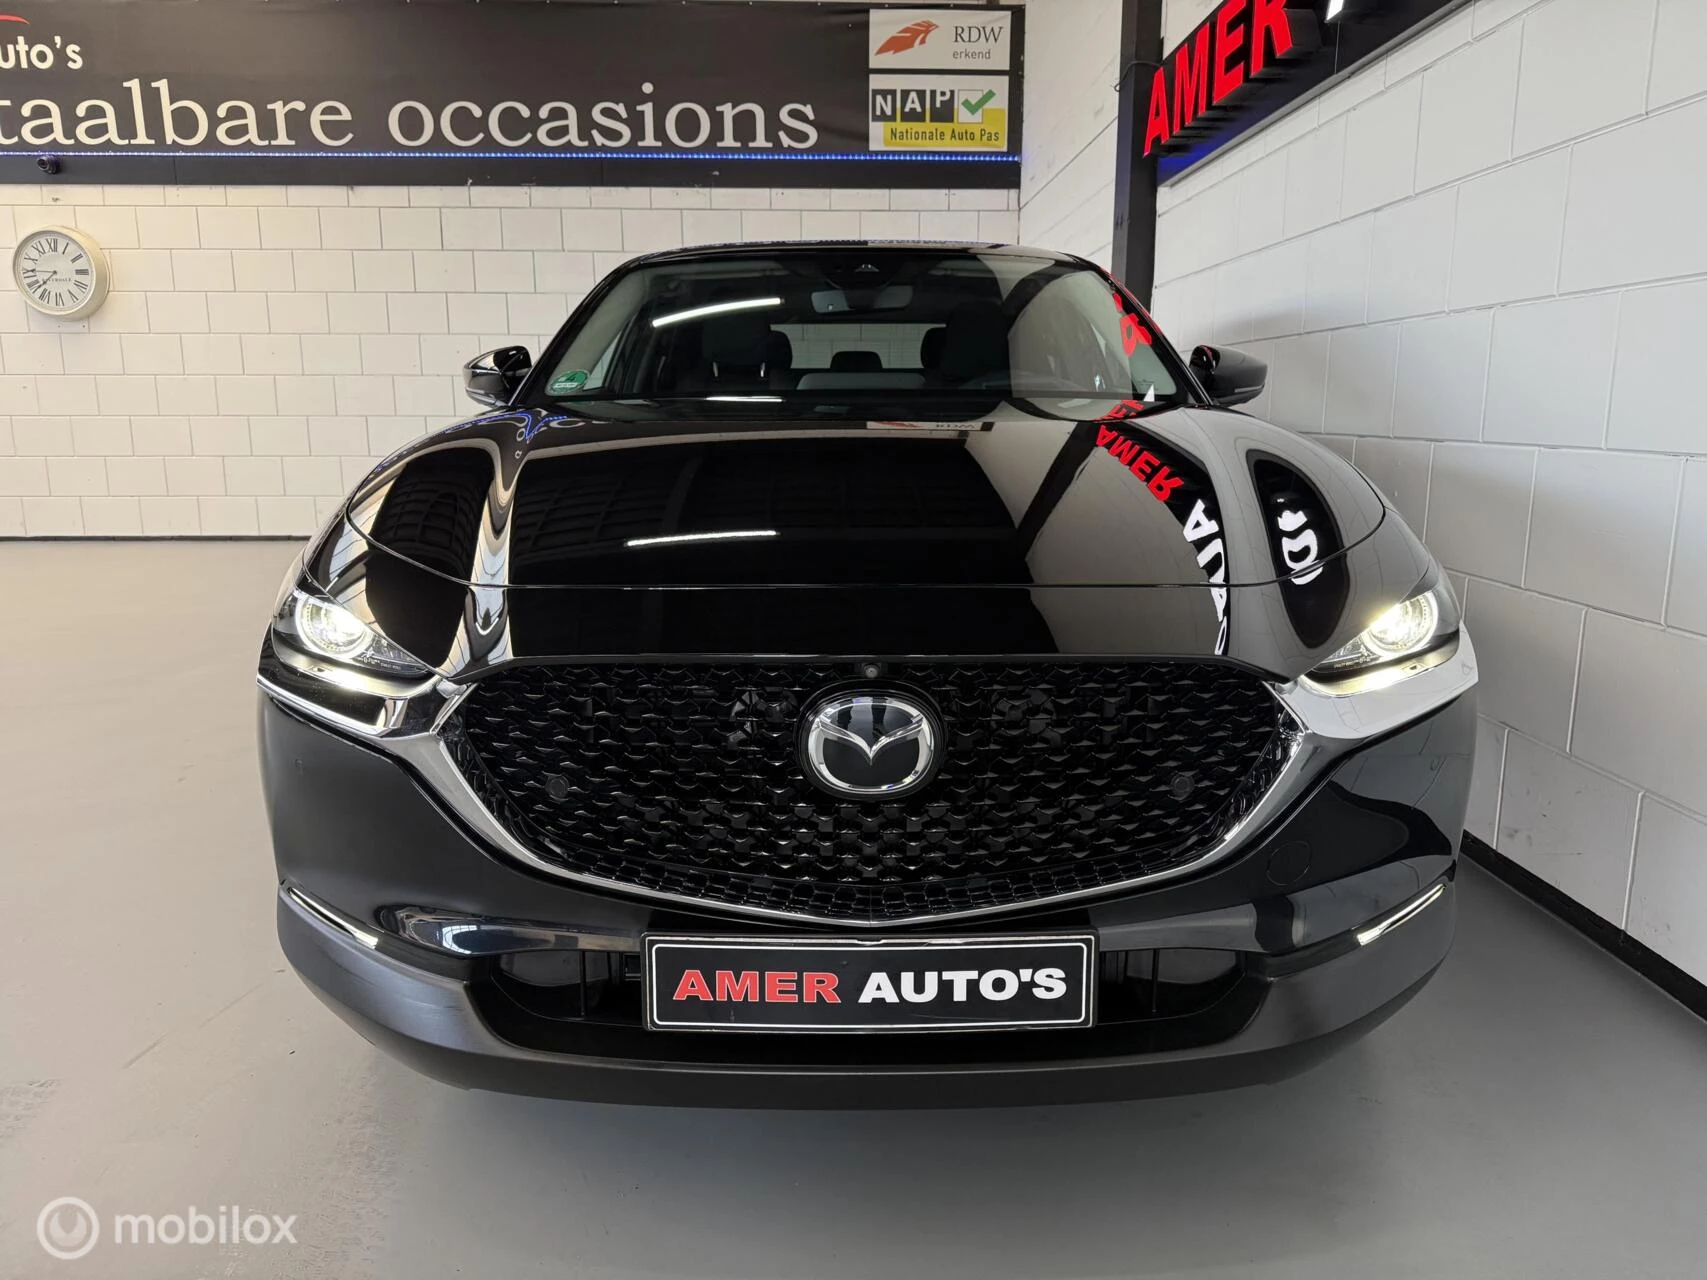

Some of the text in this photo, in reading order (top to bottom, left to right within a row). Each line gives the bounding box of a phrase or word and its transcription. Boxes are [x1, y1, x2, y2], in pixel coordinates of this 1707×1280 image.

[953, 25, 1004, 44] RDW
[952, 49, 991, 60] erkend
[1143, 0, 1293, 158] AMER
[388, 82, 819, 150] occasions
[890, 128, 1000, 142] Nationale Auto Pas
[672, 967, 1068, 1004] AMER AUTO'S
